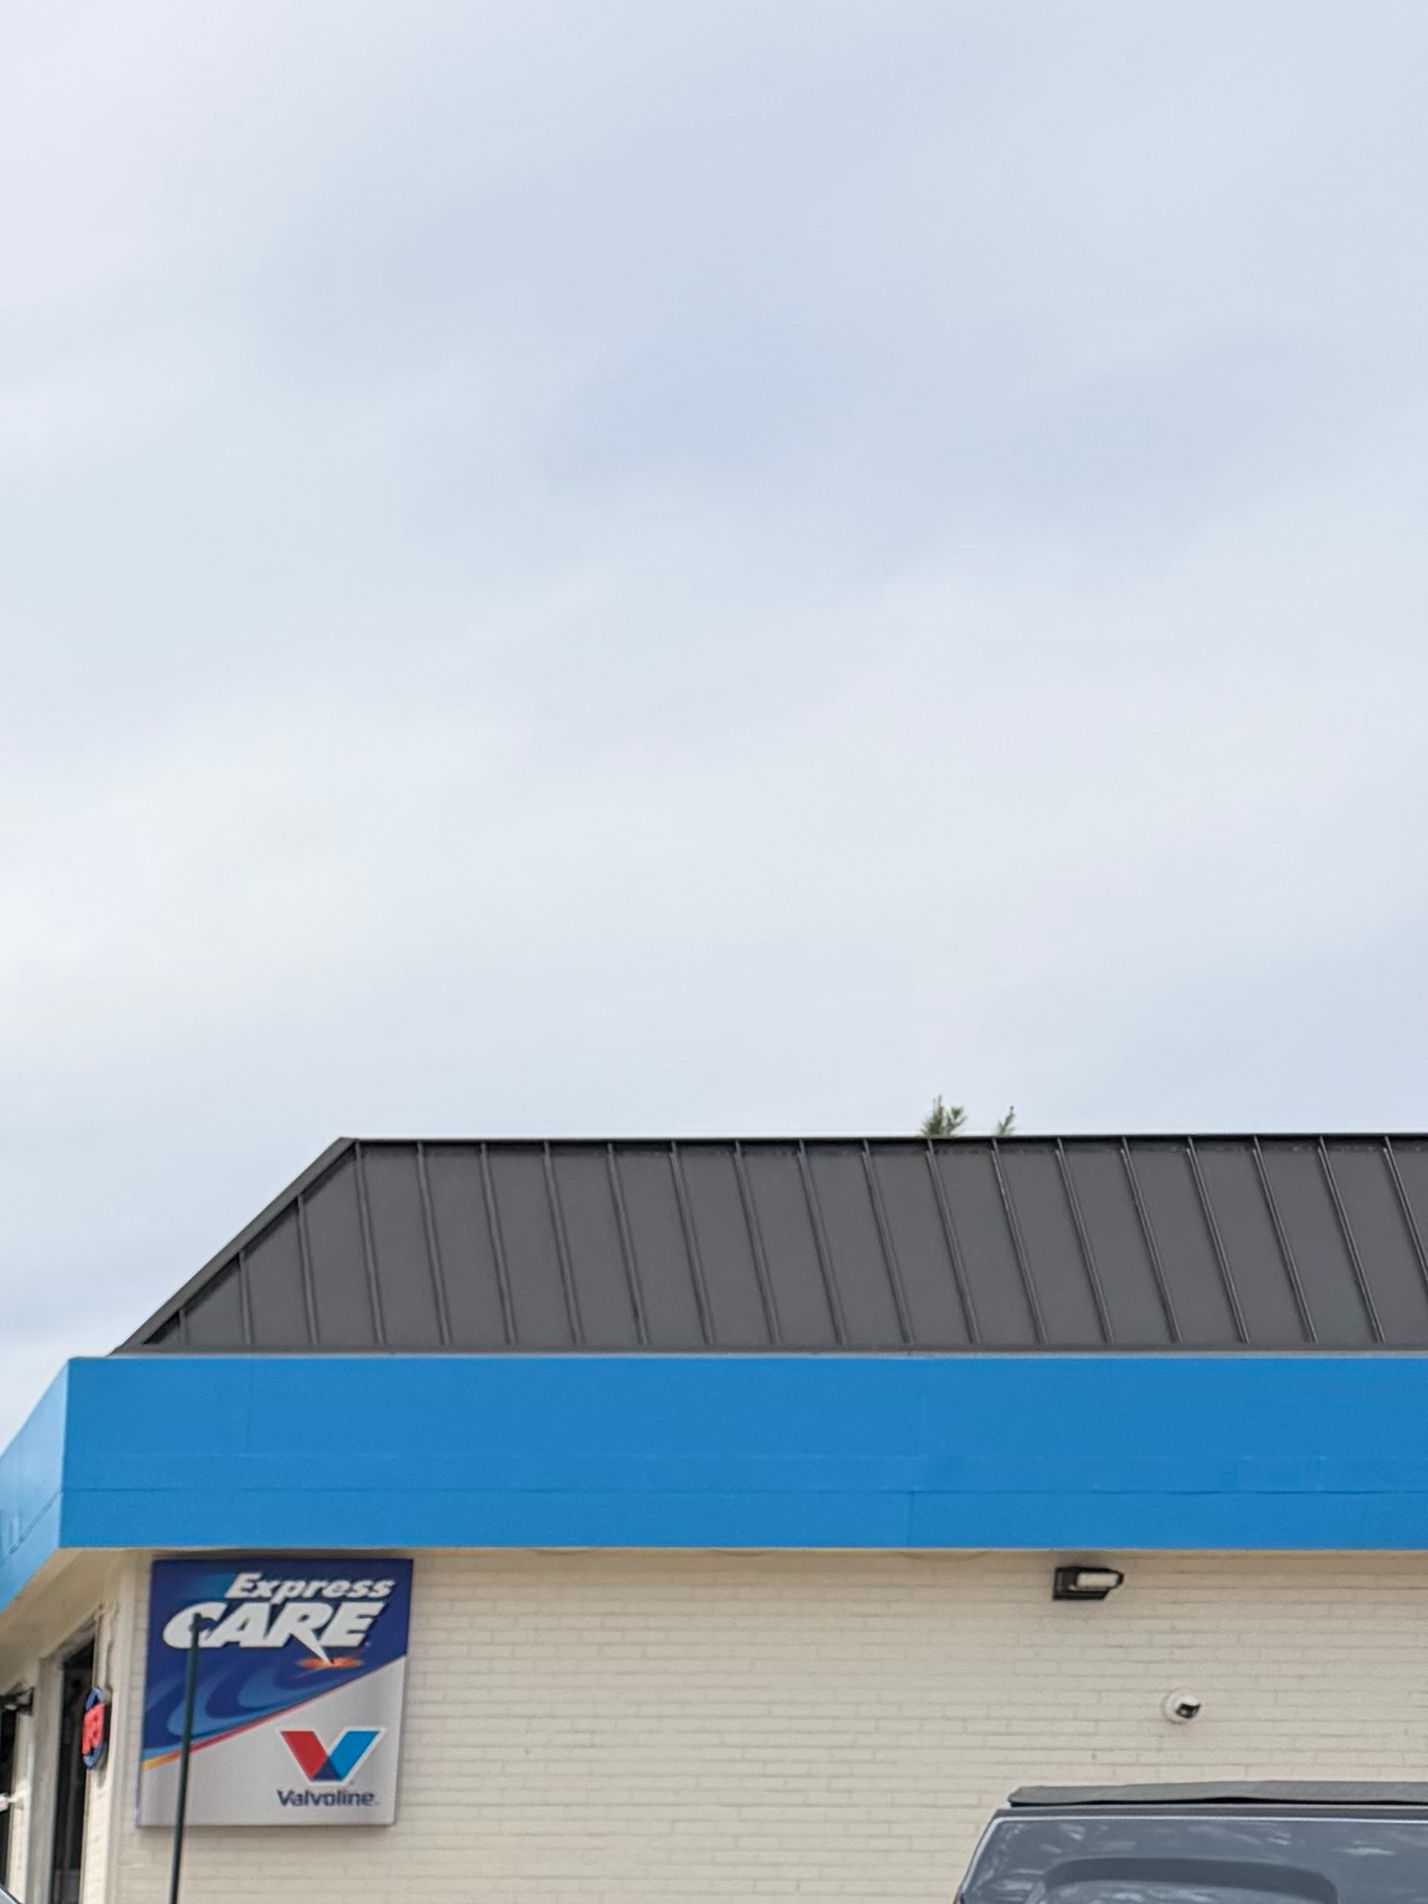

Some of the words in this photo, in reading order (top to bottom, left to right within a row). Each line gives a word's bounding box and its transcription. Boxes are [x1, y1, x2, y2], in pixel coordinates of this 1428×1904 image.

[224, 1572, 397, 1605] Express
[162, 1602, 385, 1662] CARE
[277, 1790, 375, 1807] Valvoline
